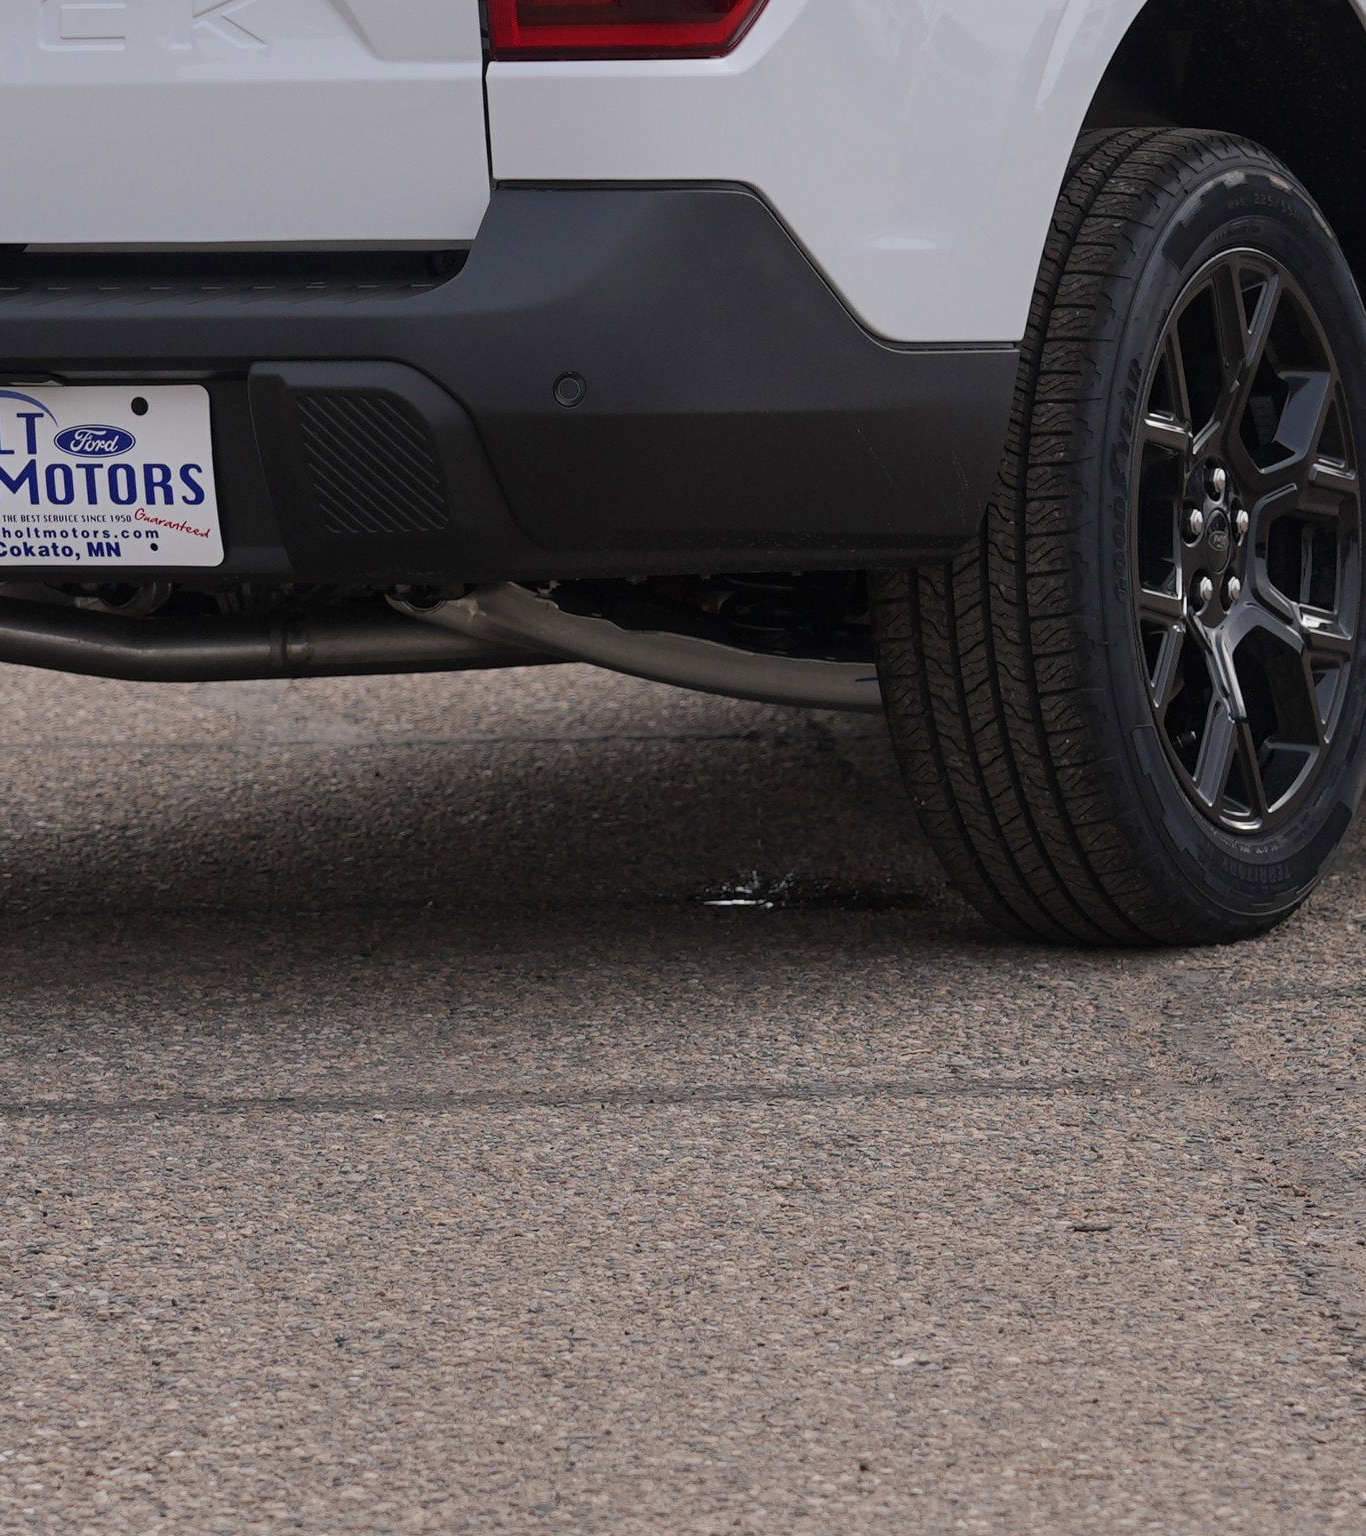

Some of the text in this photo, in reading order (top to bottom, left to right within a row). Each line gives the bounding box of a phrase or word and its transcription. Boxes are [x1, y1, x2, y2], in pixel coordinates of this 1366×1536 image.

[69, 429, 119, 453] Ford
[2, 514, 18, 523] THE
[20, 514, 40, 523] BEST
[43, 514, 78, 523] SERVICE
[81, 514, 107, 523] SINCE
[110, 514, 132, 523] 1950
[134, 507, 211, 539] Guaranteed
[87, 542, 122, 557] MN
